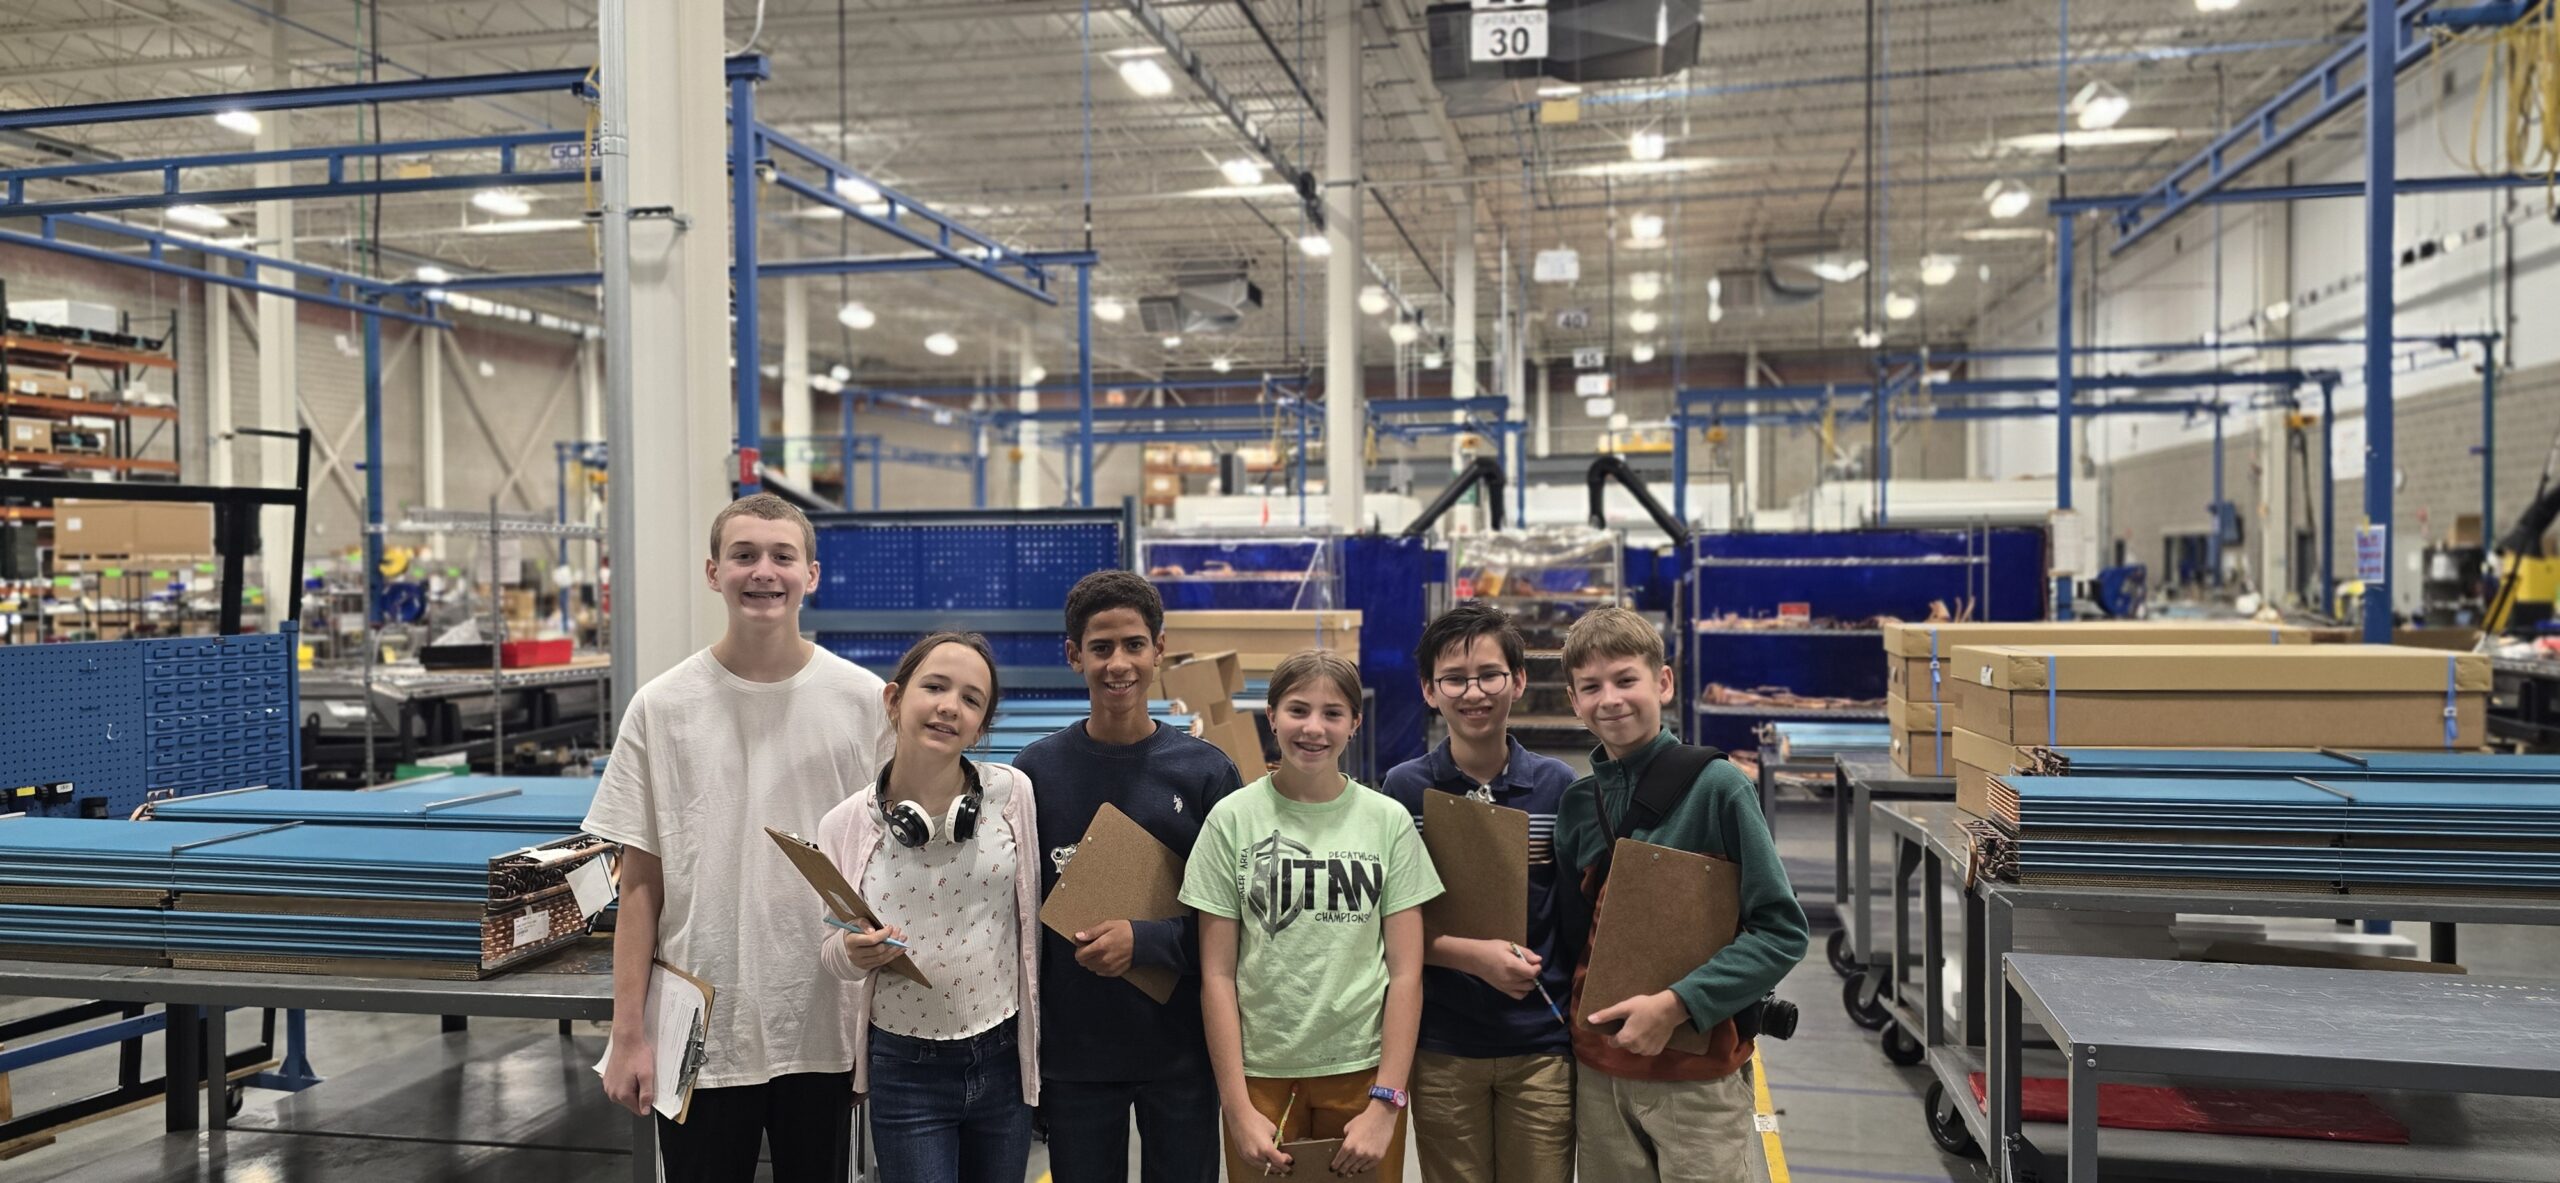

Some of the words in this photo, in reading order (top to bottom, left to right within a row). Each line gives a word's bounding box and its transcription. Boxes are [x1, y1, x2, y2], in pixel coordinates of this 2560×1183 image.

[1489, 26, 1529, 57] 30
[1562, 314, 1583, 329] 40
[1579, 353, 1597, 366] 45
[1240, 847, 1250, 870] AREA
[1328, 850, 1380, 863] DECATHLON
[1238, 874, 1247, 906] SHALER
